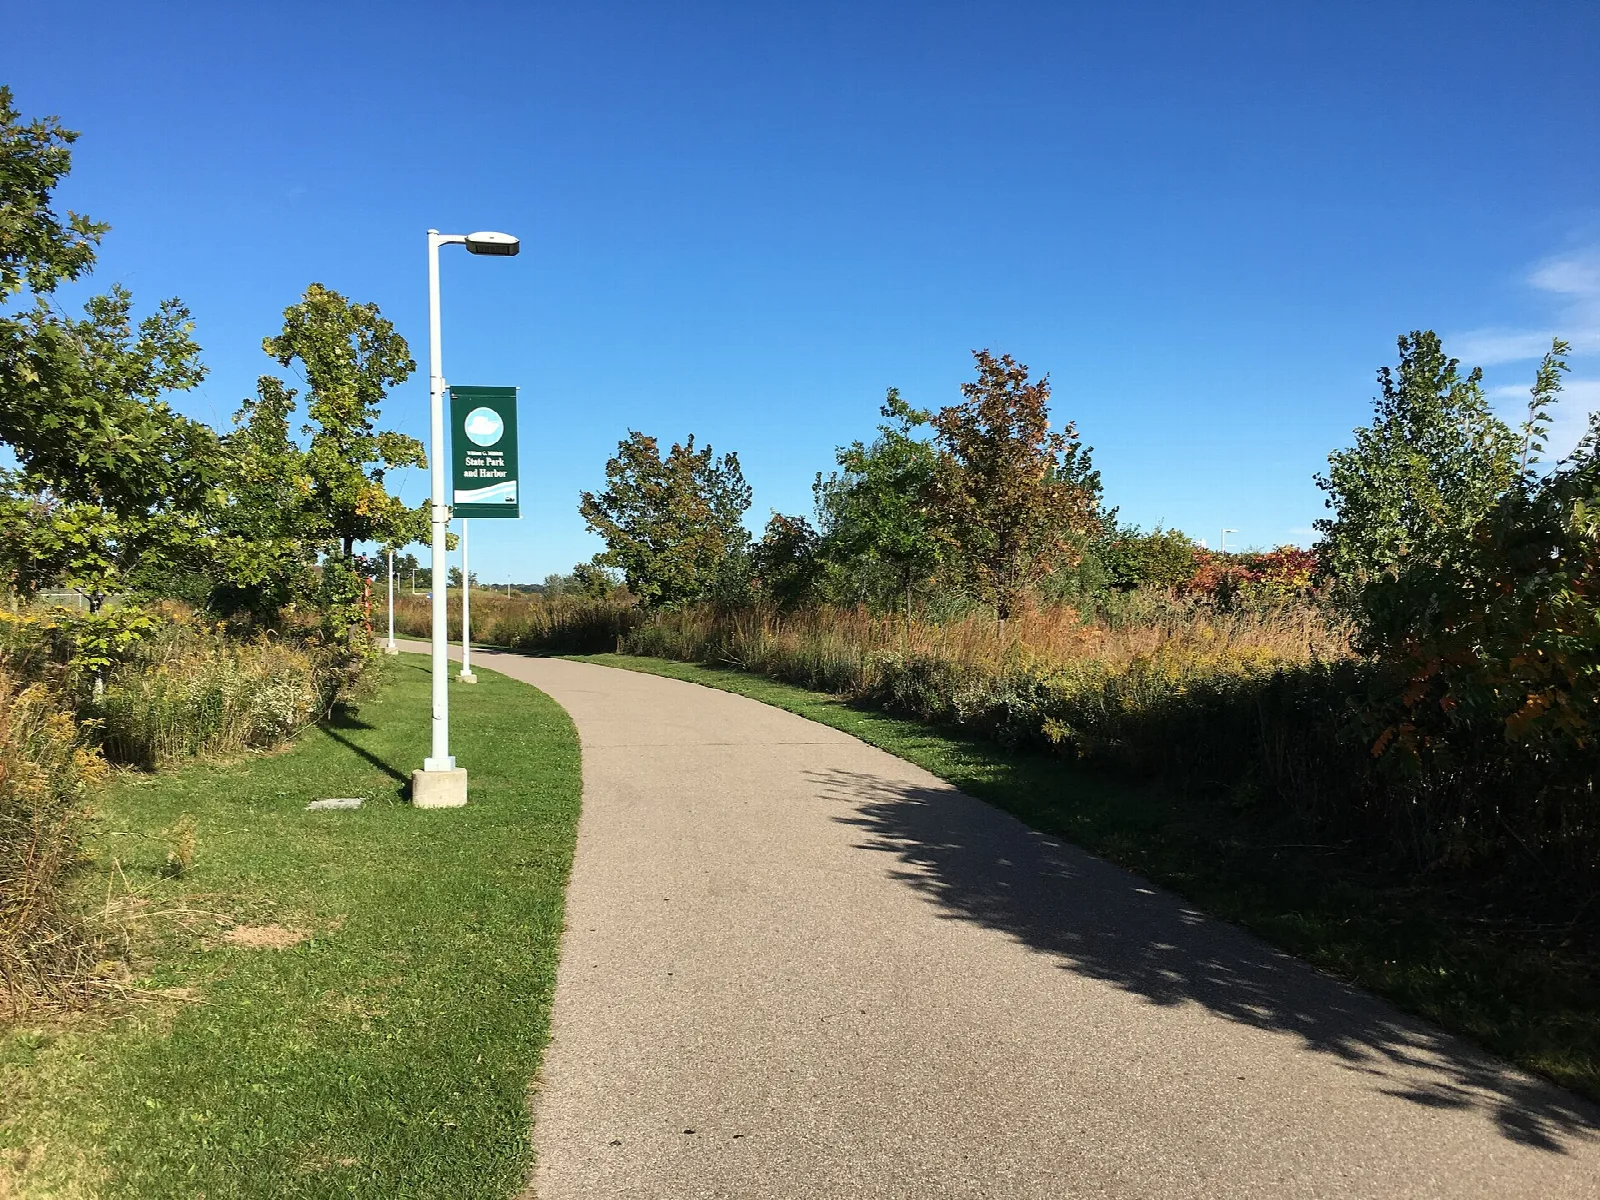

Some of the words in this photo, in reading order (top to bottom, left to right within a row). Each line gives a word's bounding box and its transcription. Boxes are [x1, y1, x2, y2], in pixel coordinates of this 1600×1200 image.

[465, 457, 485, 466] State
[486, 457, 505, 466] Park
[464, 468, 478, 477] and
[479, 468, 507, 477] Harbor
